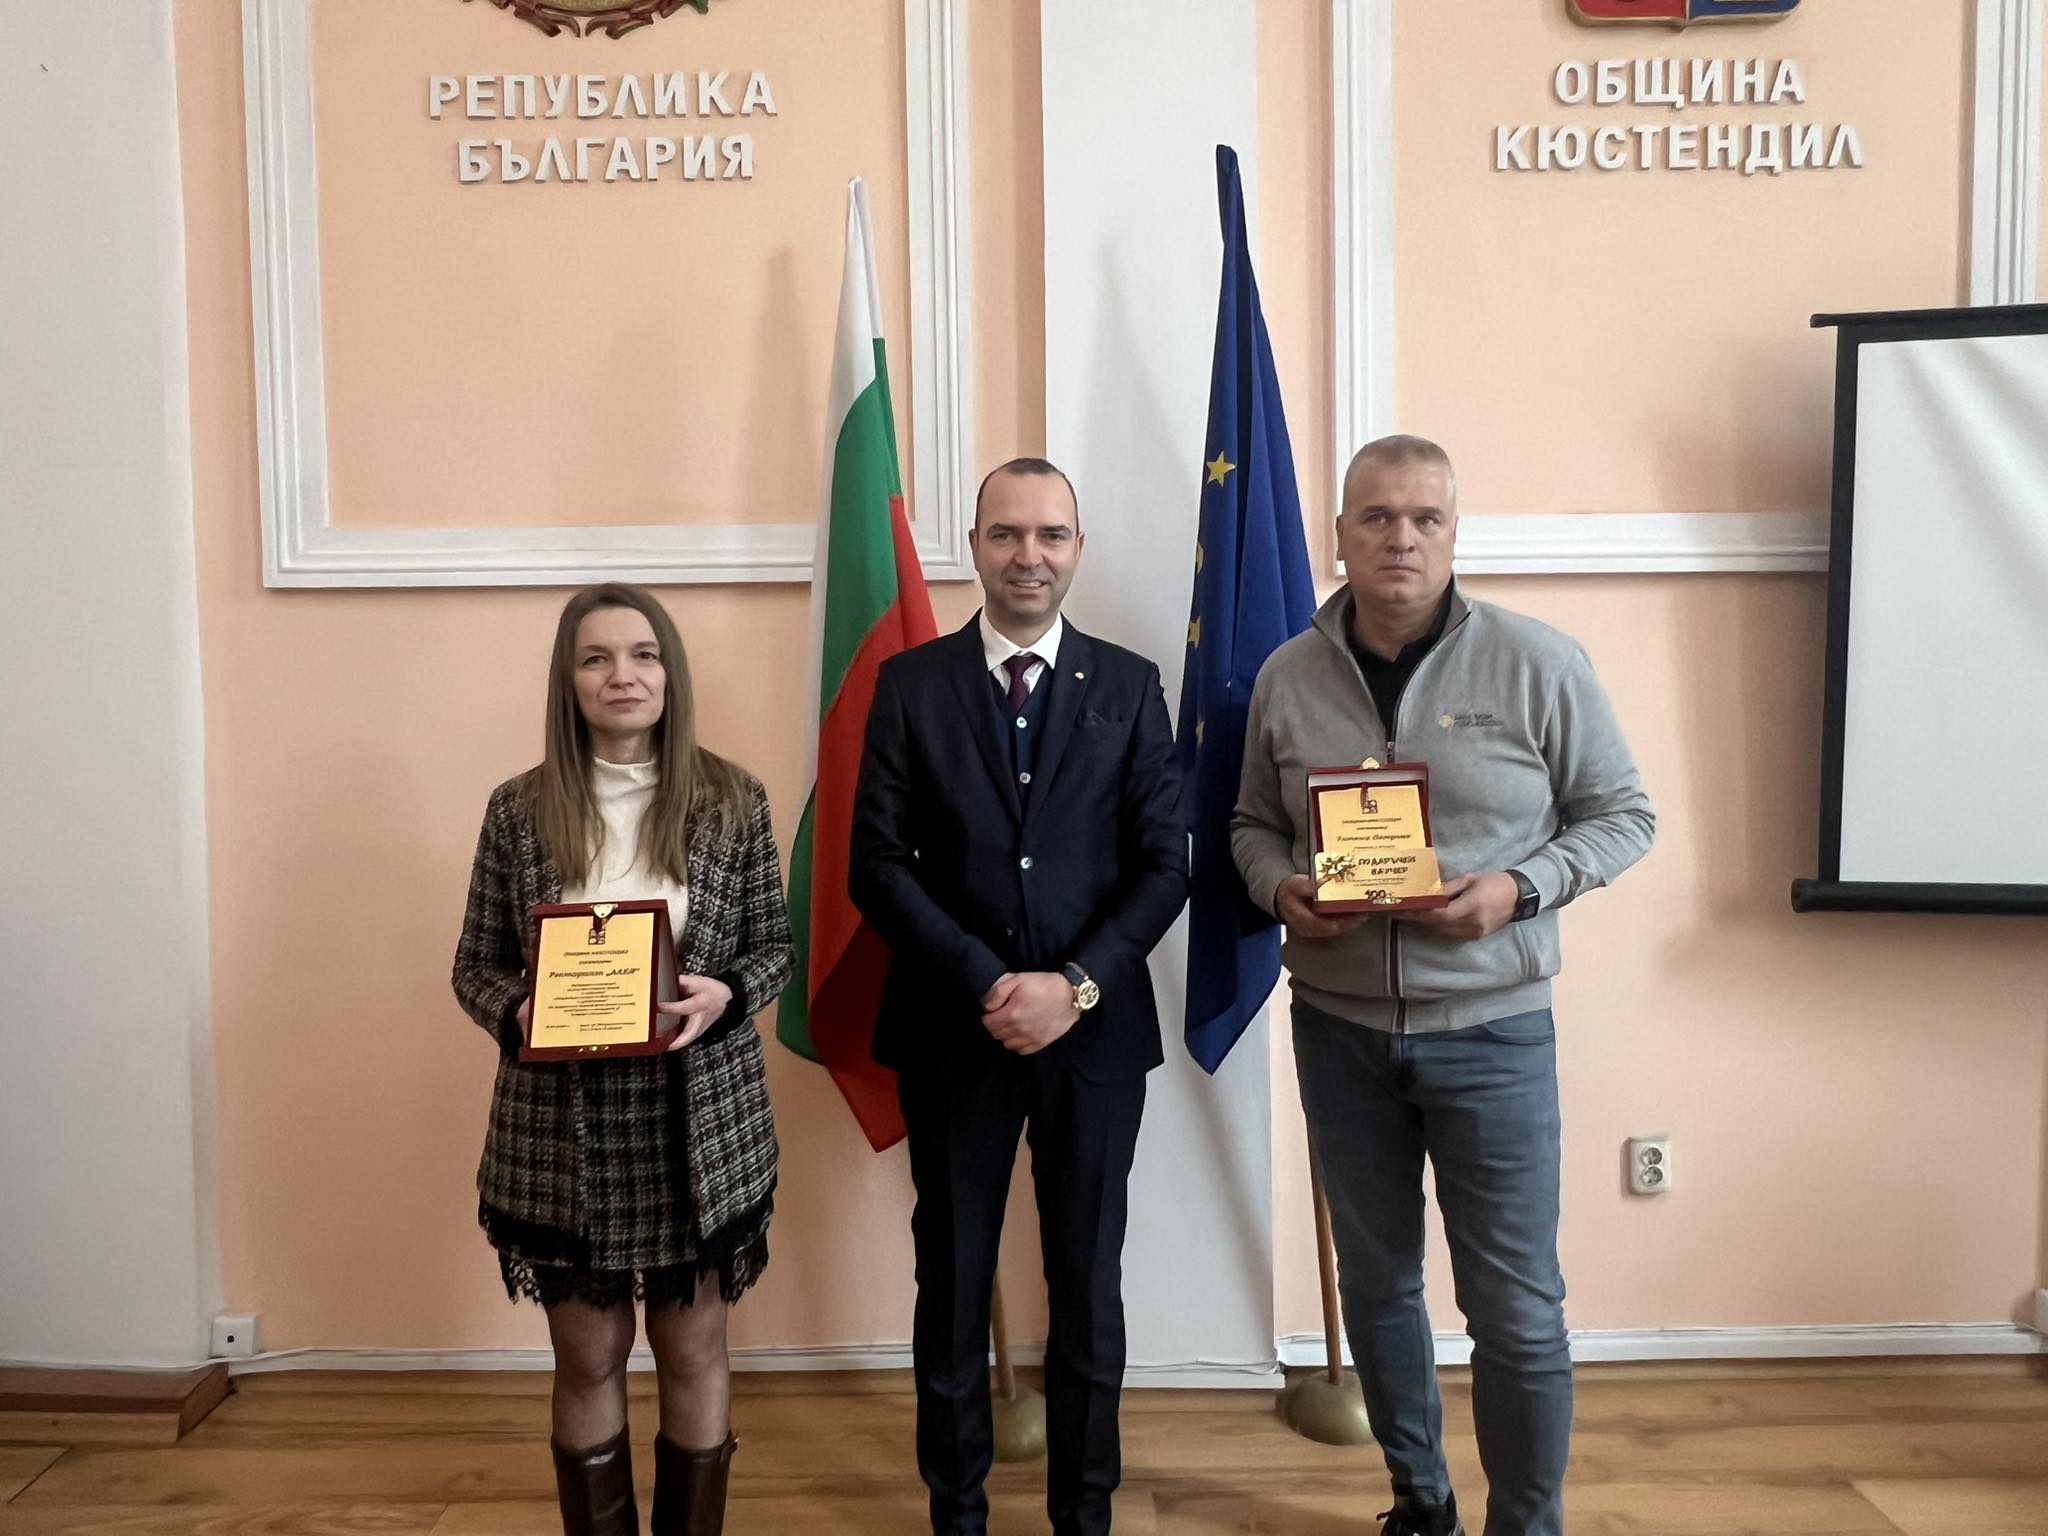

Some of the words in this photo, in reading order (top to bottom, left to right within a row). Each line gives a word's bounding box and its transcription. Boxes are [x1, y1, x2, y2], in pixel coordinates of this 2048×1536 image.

[429, 71, 779, 120] РЕПУБЛИКА
[1554, 57, 1806, 110] ОБЩИНА
[458, 134, 754, 183] БЪЛГАРИЯ
[1495, 123, 1864, 176] КЮСТЕНДИЛ
